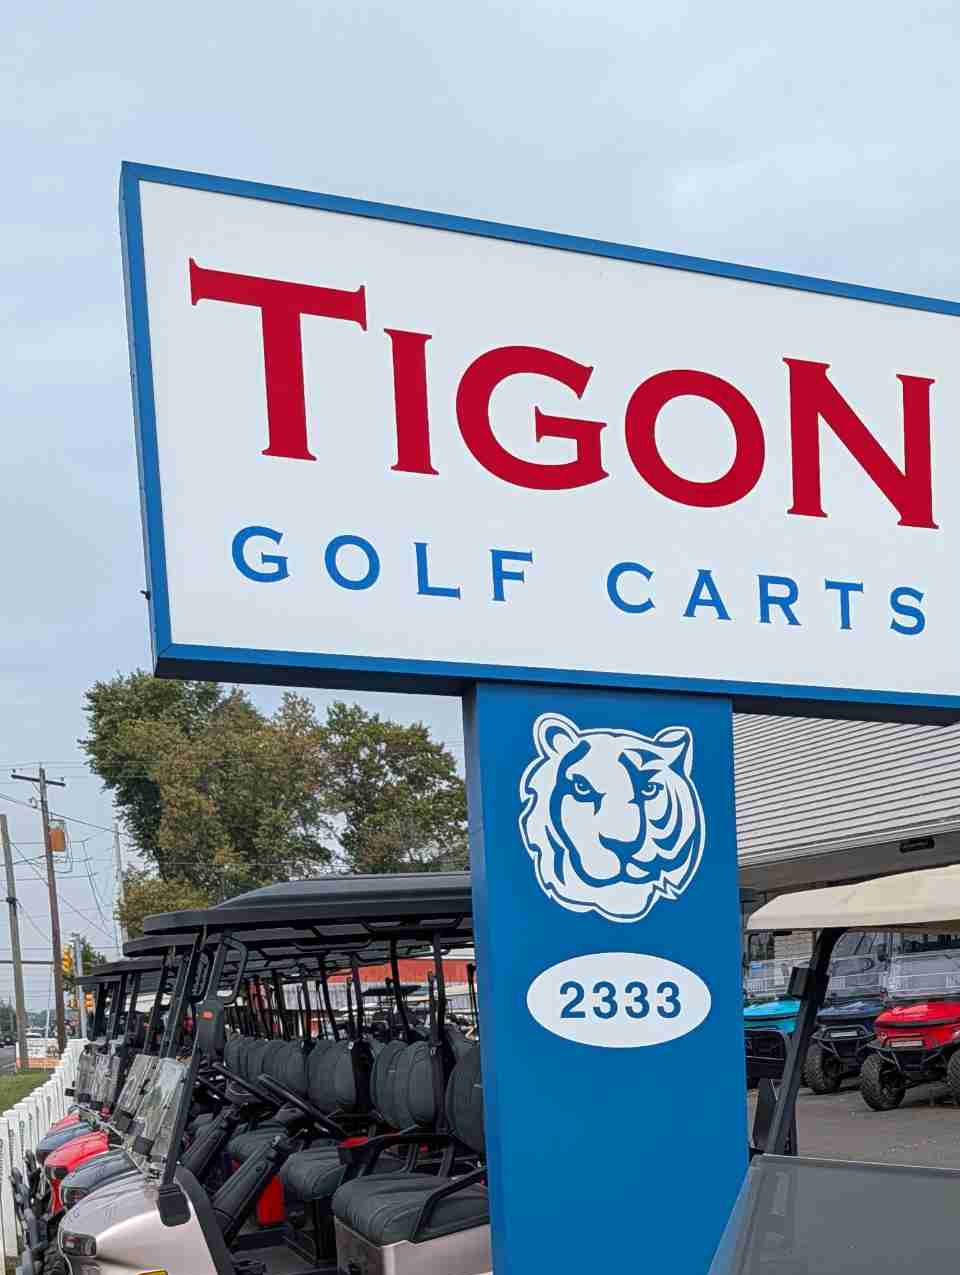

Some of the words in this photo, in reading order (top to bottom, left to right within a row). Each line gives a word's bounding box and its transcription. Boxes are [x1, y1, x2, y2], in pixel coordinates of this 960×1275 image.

[190, 257, 939, 529] TIGON
[232, 525, 533, 602] GOLF
[607, 561, 926, 637] CARTS
[559, 980, 681, 1020] 2333
